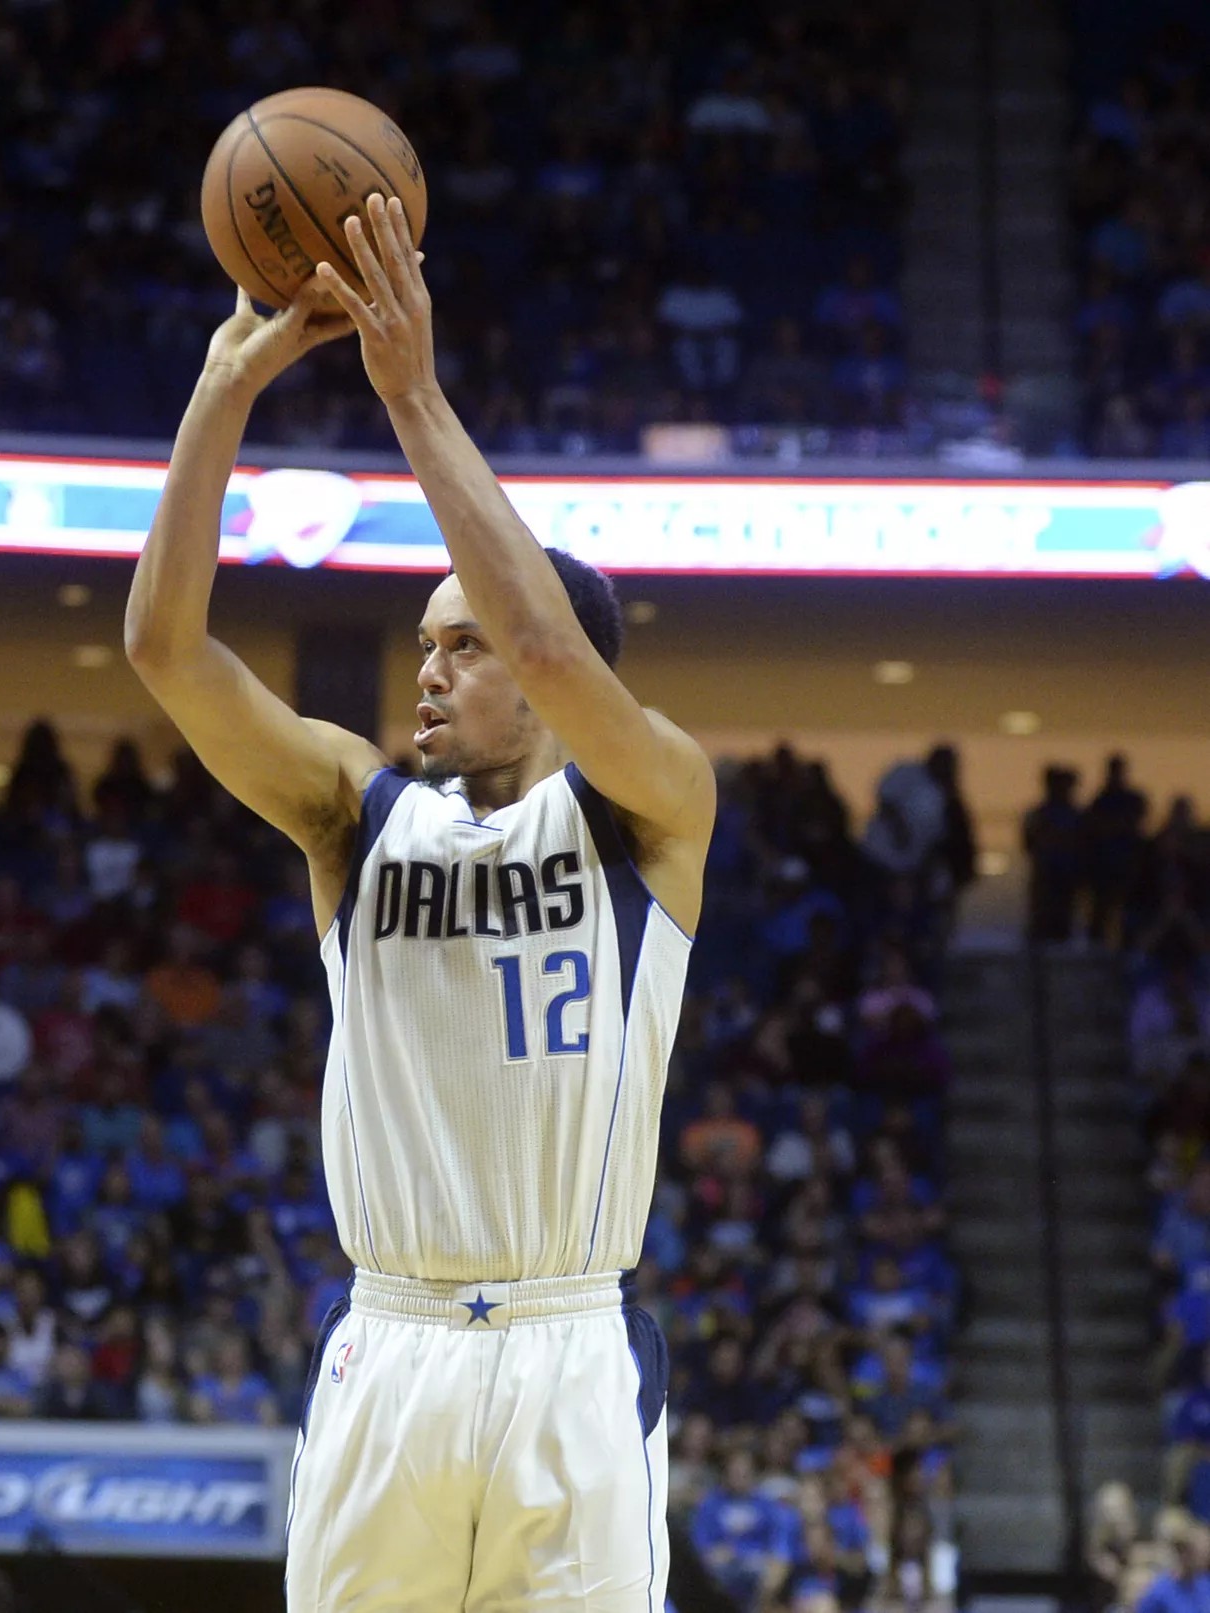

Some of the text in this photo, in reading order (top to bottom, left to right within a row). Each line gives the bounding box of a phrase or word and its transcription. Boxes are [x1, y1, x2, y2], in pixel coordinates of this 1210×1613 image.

[244, 176, 317, 278] LDING
[374, 851, 586, 942] DALLAS
[490, 950, 591, 1065] 12
